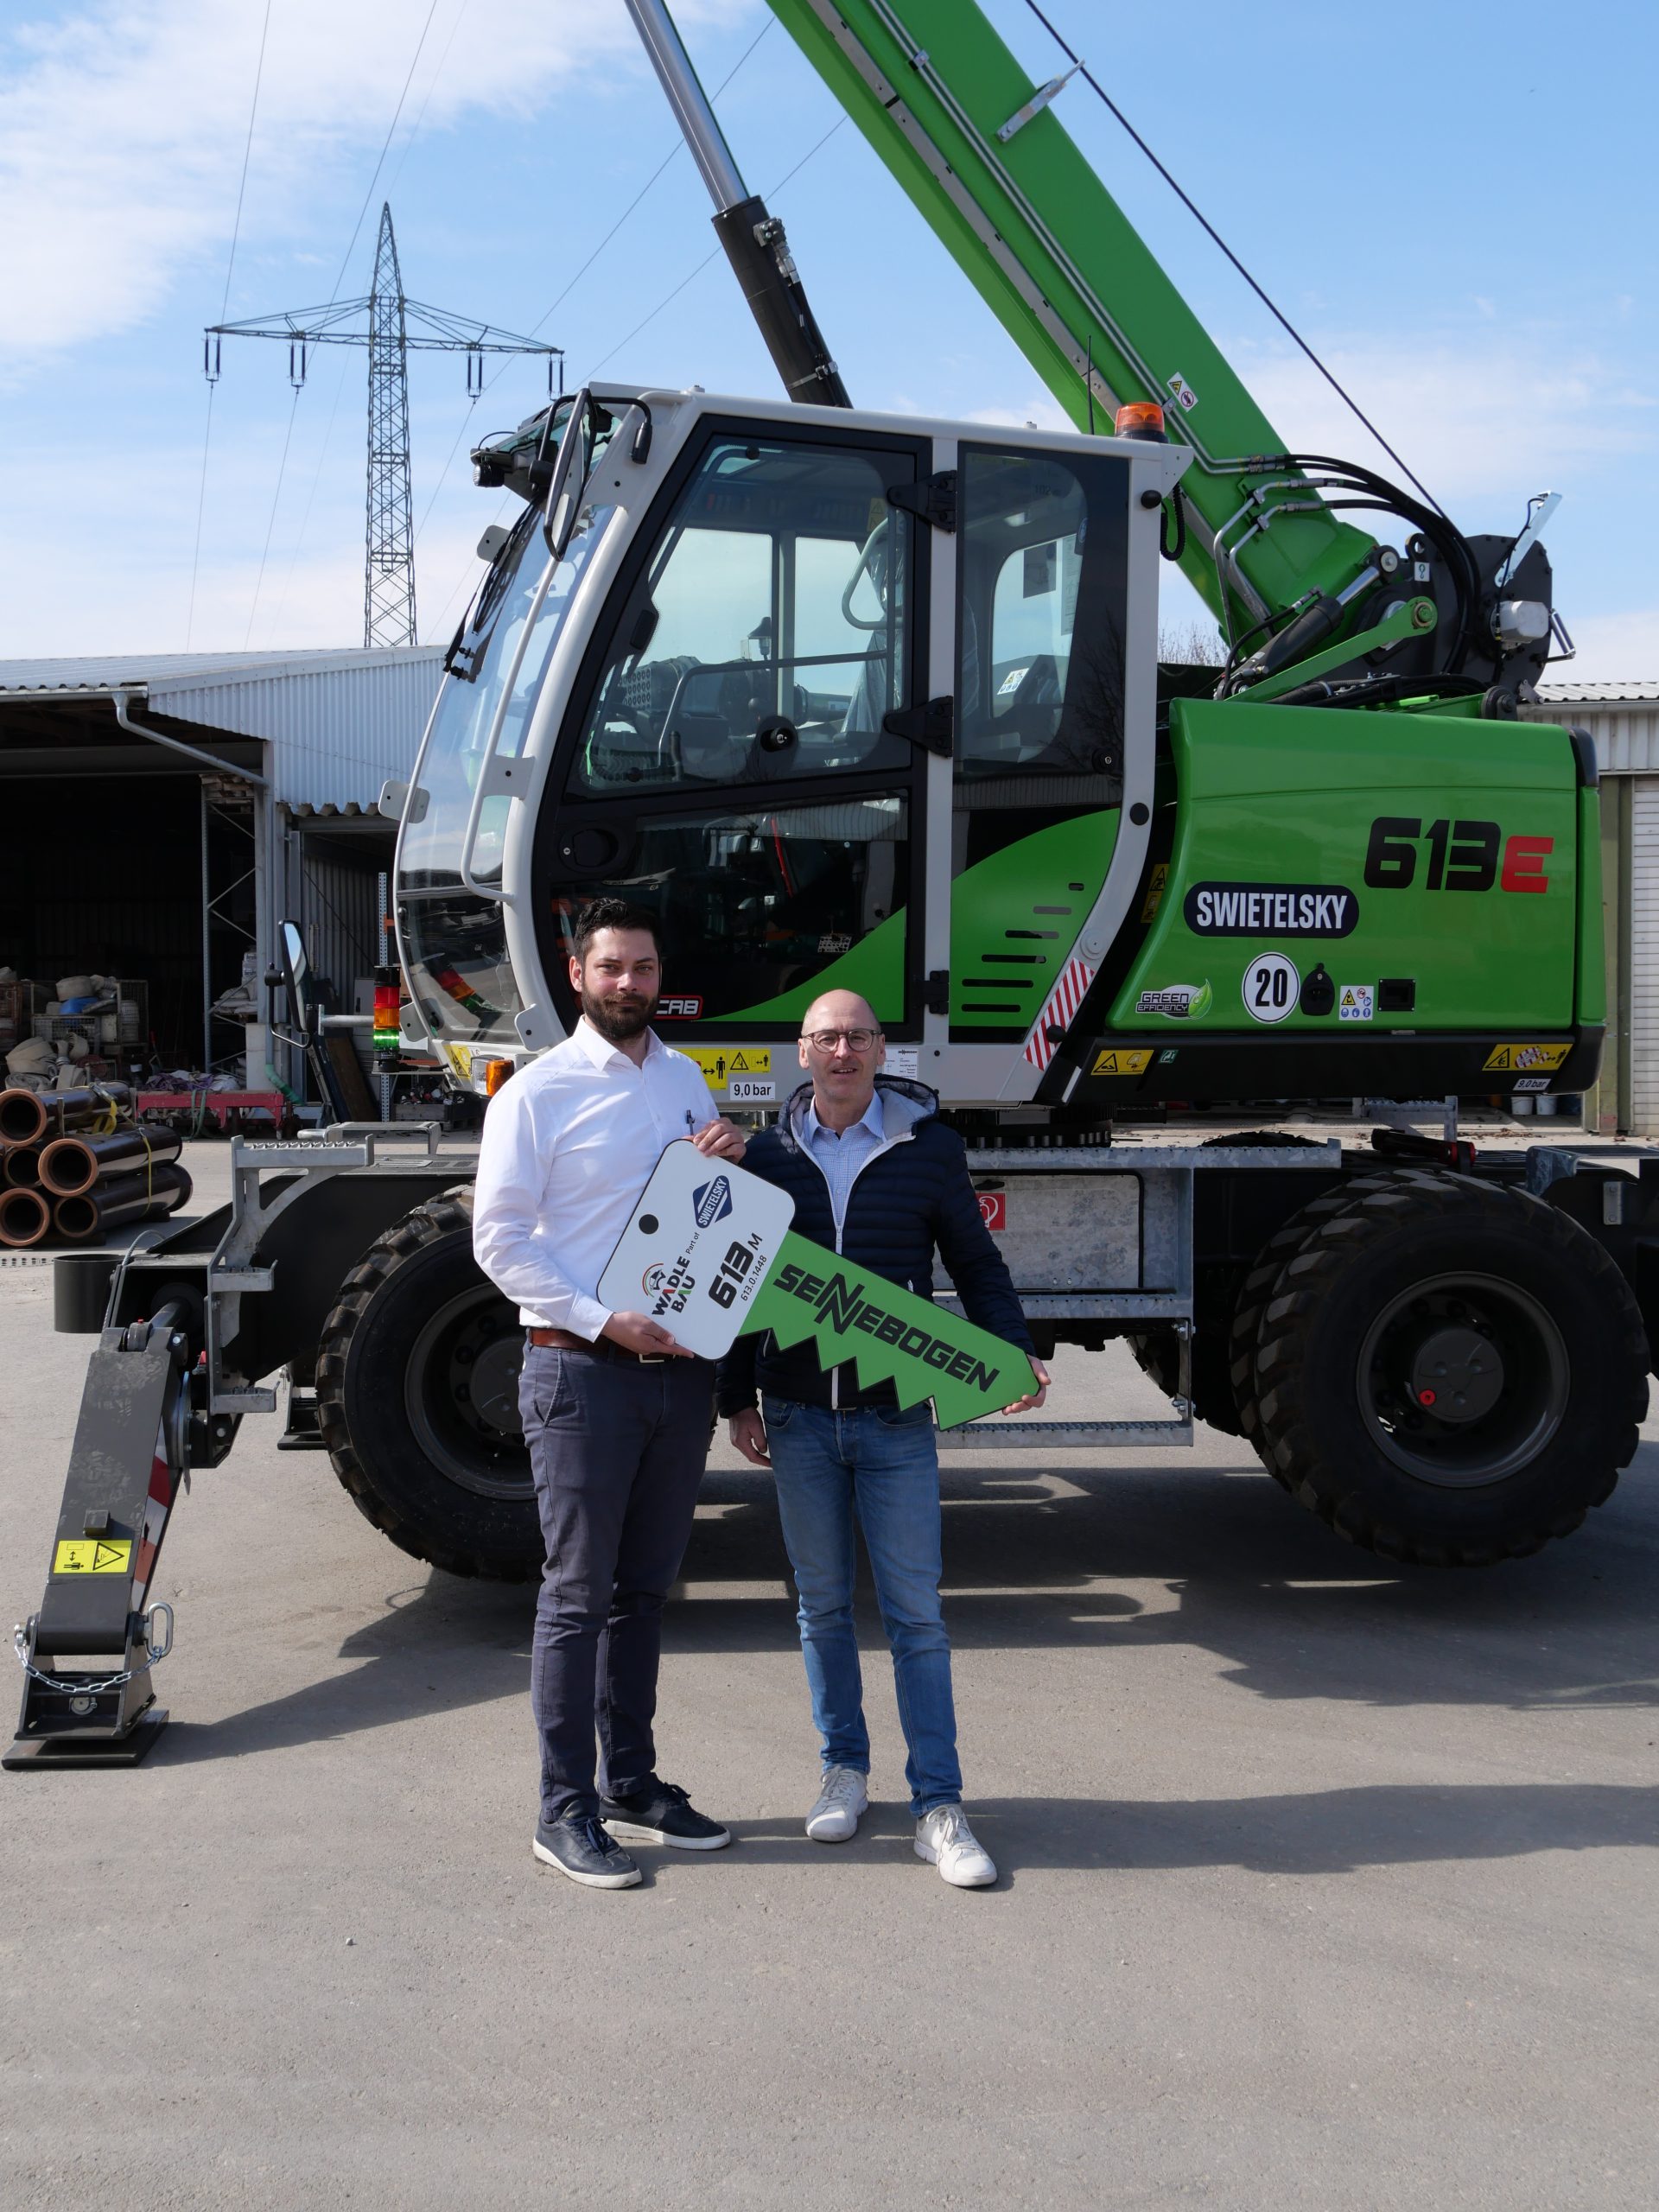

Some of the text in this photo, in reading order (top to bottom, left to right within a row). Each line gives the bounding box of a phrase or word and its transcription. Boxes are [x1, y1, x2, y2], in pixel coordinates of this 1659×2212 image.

[1197, 891, 1347, 929] SWIETELSKY
[1141, 994, 1190, 1003] GREEN
[1255, 969, 1287, 1007] 20
[734, 1084, 772, 1097] 9,0 bar
[698, 1178, 727, 1226] SWIETELSKY
[685, 1231, 700, 1255] Part of
[652, 1255, 690, 1316] WADLE
[709, 1232, 763, 1309] 613 M
[741, 1255, 767, 1301] 613.0.1448
[671, 1274, 696, 1313] BAU
[772, 1263, 1001, 1393] SENNEBOGEN
